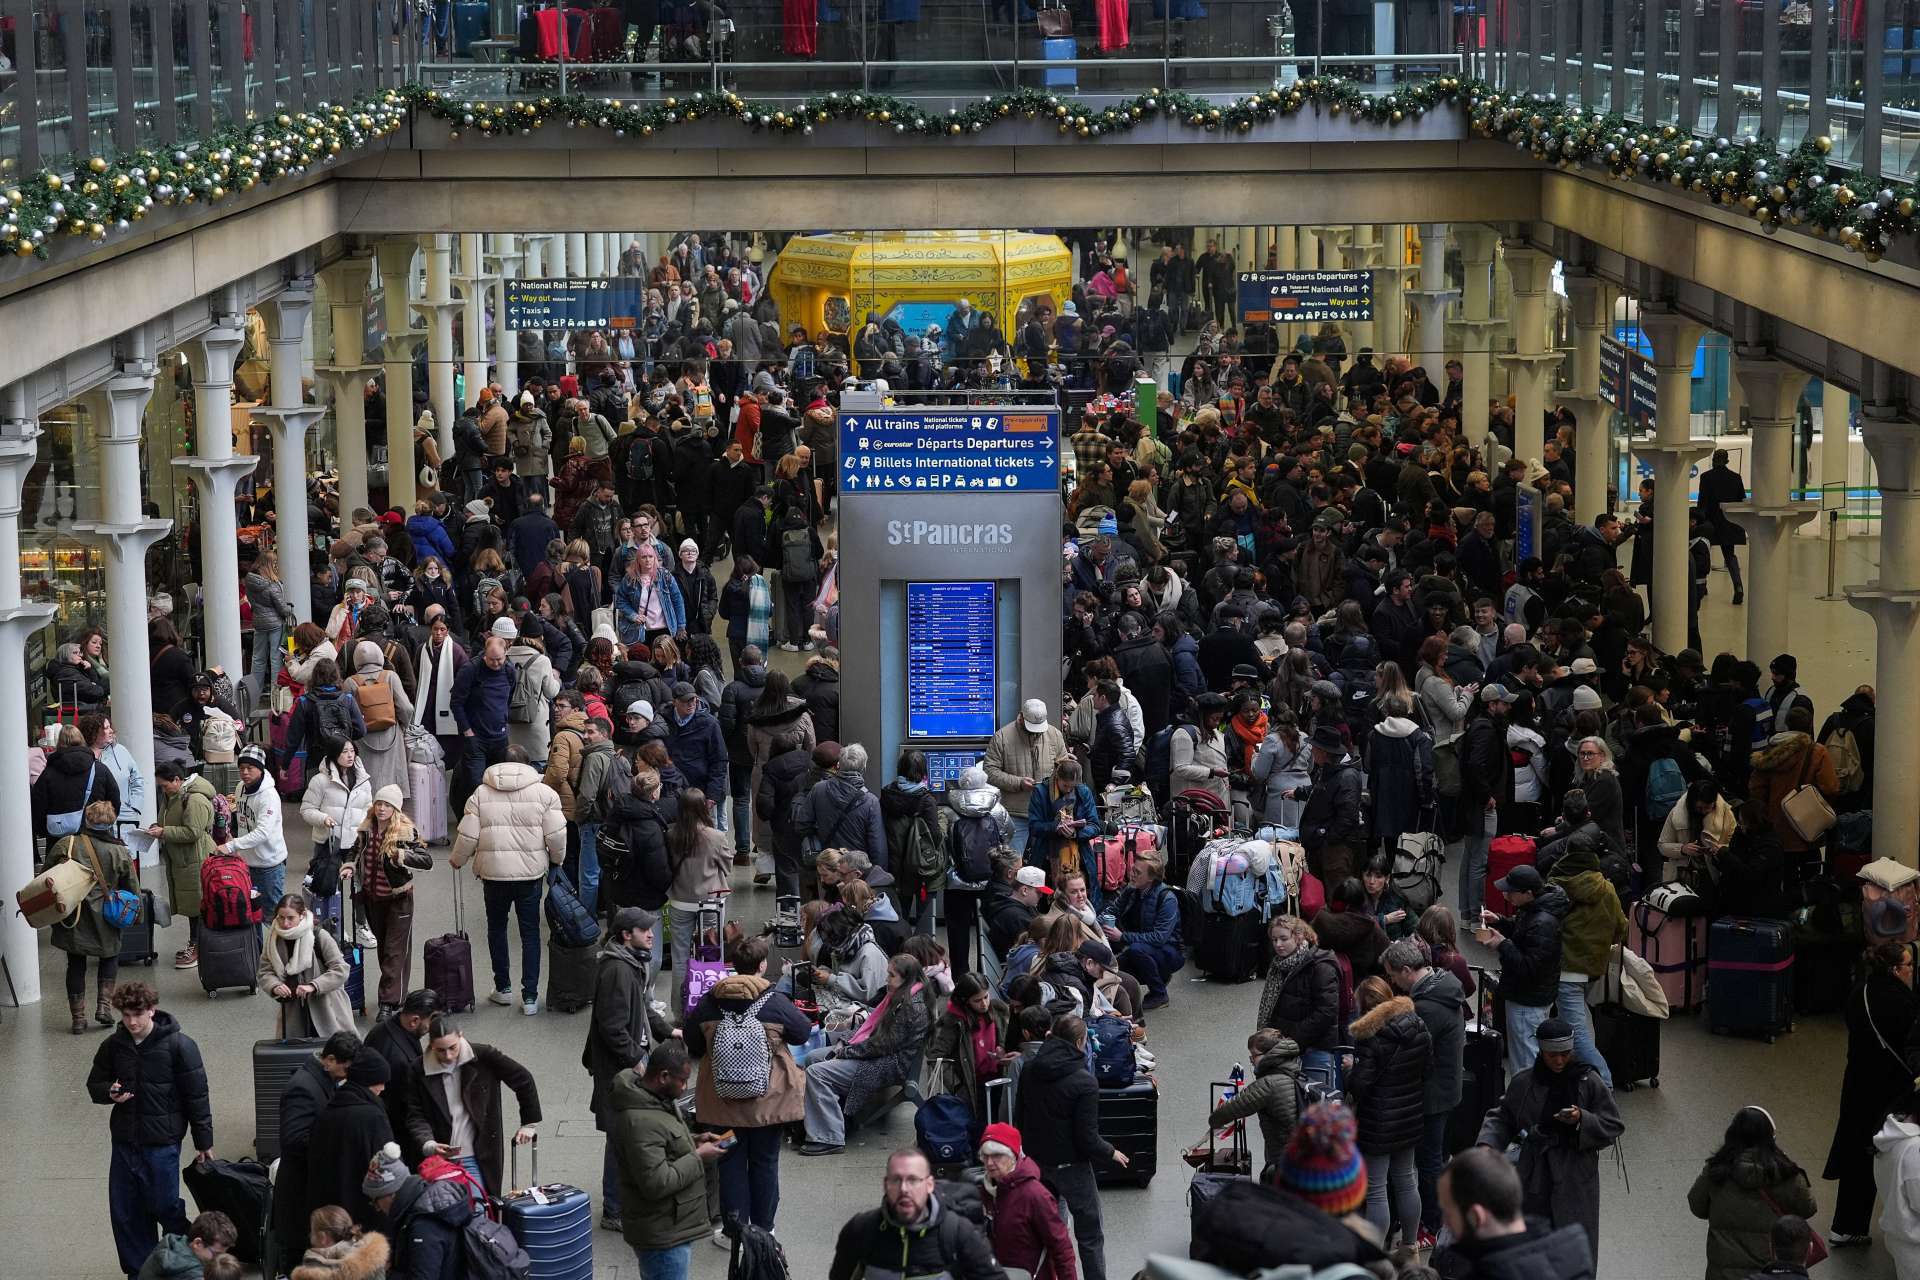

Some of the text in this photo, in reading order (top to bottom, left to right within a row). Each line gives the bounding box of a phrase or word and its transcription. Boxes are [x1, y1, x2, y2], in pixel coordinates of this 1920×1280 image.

[1286, 272, 1358, 281] Départs Departures
[521, 295, 536, 303] Way
[865, 419, 920, 429] All trains
[917, 438, 1034, 451] Départs Departures
[874, 457, 1034, 468] Billets International tickets
